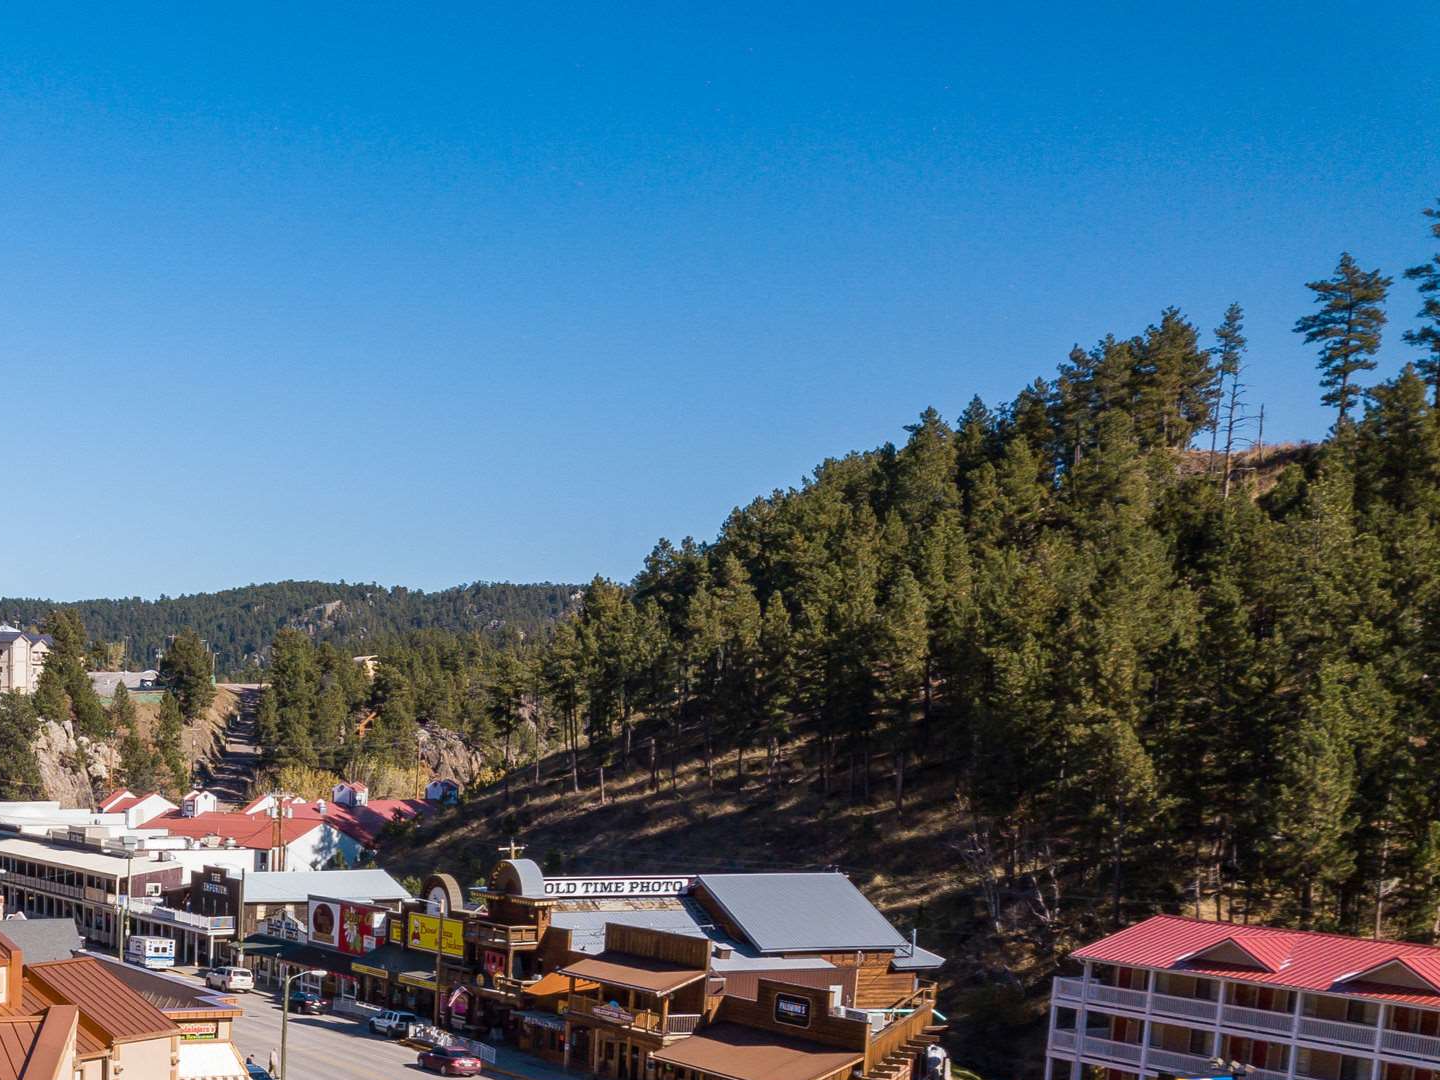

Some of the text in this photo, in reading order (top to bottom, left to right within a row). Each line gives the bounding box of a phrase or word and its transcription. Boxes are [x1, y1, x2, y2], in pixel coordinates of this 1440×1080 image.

[544, 879, 683, 894] OLD TIME PHOTO
